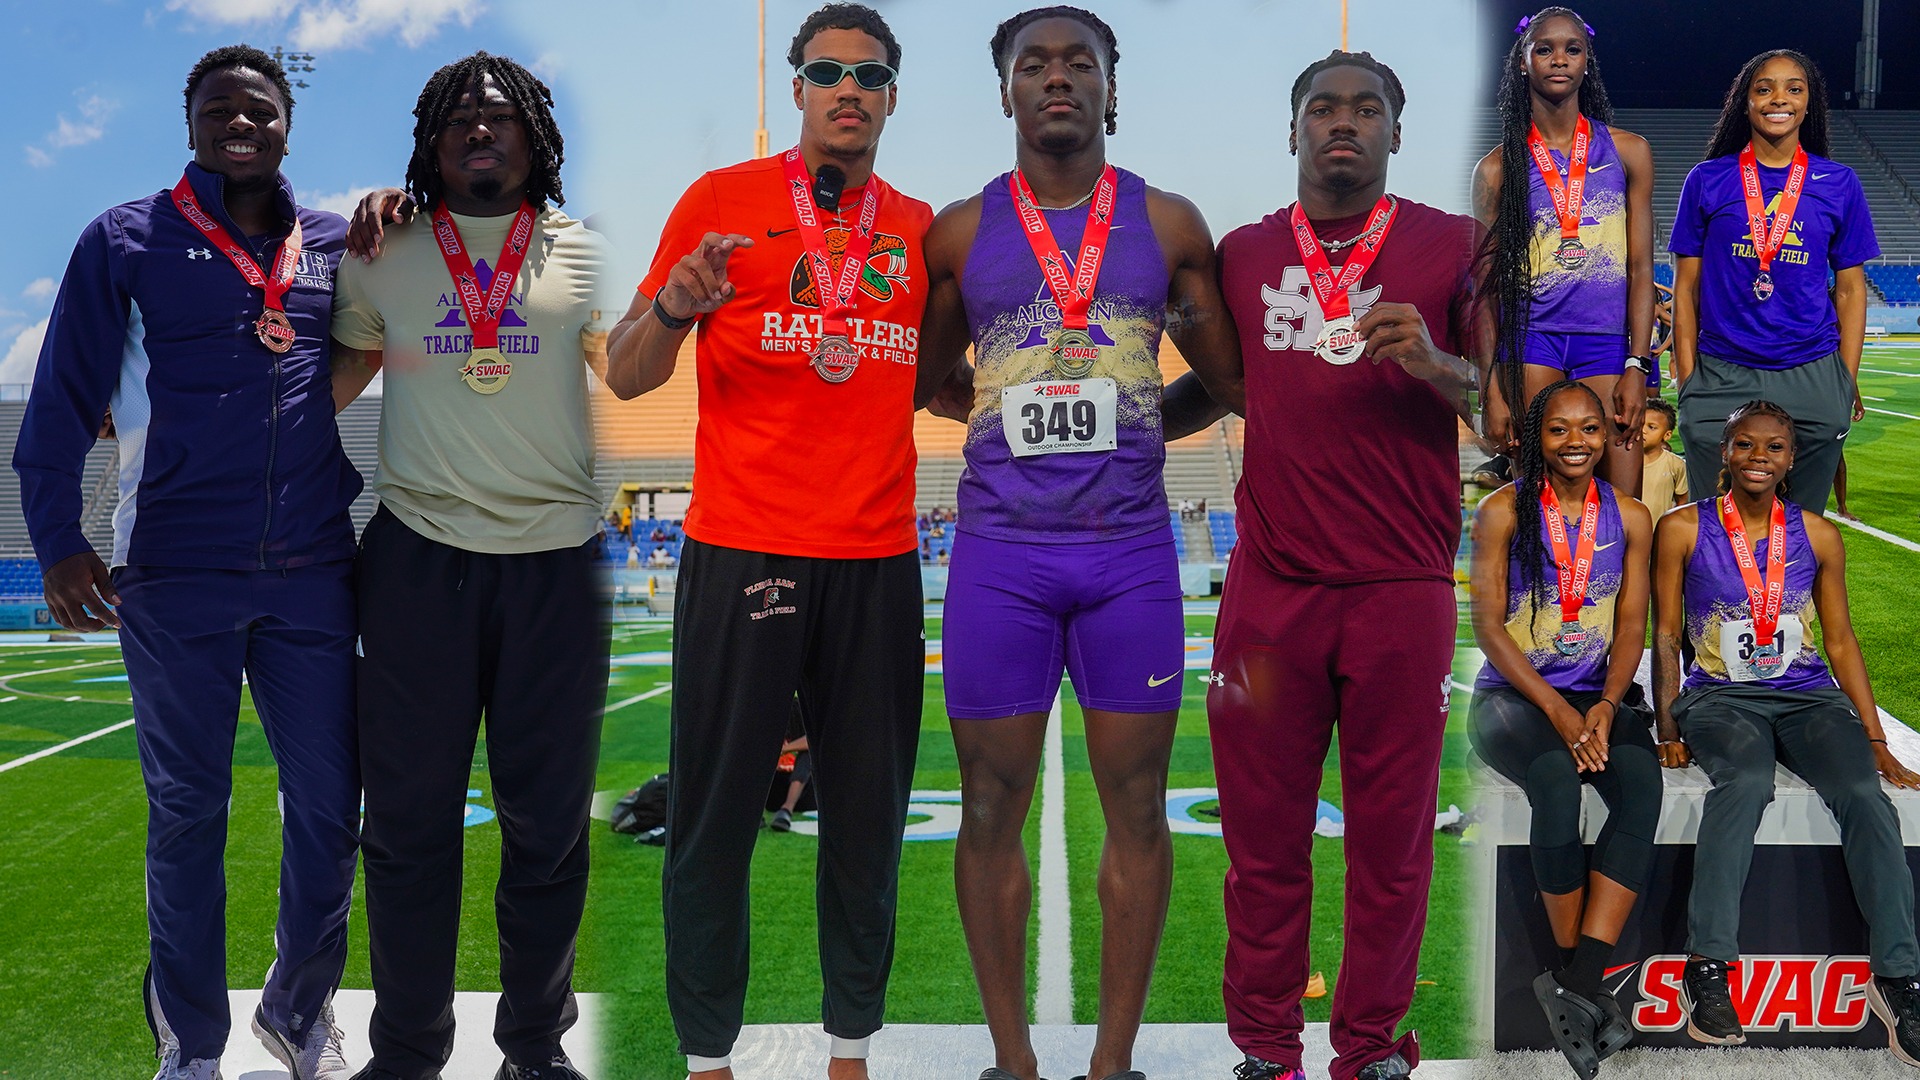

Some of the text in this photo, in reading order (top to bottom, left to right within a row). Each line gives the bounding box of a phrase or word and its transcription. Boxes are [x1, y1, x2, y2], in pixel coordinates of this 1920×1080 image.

[1790, 164, 1804, 192] SWAC
[792, 188, 817, 227] SWAC
[859, 191, 877, 229] SWAC
[1097, 179, 1114, 214] SWAC
[1568, 180, 1582, 212] SWAC
[184, 205, 218, 231] SWAC
[512, 211, 532, 246] SWAC
[1772, 213, 1790, 244] SWAC
[438, 224, 462, 255] SWAC
[1298, 227, 1318, 258] SWAC
[1732, 243, 1760, 258] TRAC
[234, 254, 265, 285] SWA
[1078, 245, 1100, 287] SWAC
[1779, 249, 1809, 265] FIELD
[488, 271, 513, 309] SWAC
[839, 257, 861, 297] SWAC
[1316, 275, 1333, 304] SWA
[436, 292, 523, 307] ALN
[1015, 302, 1115, 326] ALCN
[267, 324, 295, 341] SWAC
[423, 335, 540, 354] TRACK FIELD
[761, 312, 918, 352] RATLERS
[761, 339, 811, 351] MEN'S
[871, 347, 880, 359] &
[884, 350, 916, 366] FIELD
[824, 353, 858, 365] SWAC
[1063, 347, 1099, 358] SWAC
[476, 364, 511, 377] SWAC
[1045, 384, 1080, 396] SWAC
[1021, 400, 1096, 444] 349
[1549, 511, 1564, 543] SWAC
[1584, 502, 1597, 531] SWAC
[1734, 537, 1753, 568] SWAC
[1773, 524, 1784, 556] SWAC
[1573, 558, 1589, 591] SWAC
[1766, 582, 1781, 615] SWAC
[1563, 633, 1587, 643] SWAC
[1738, 630, 1785, 659] 31
[1757, 656, 1781, 667] SWAC
